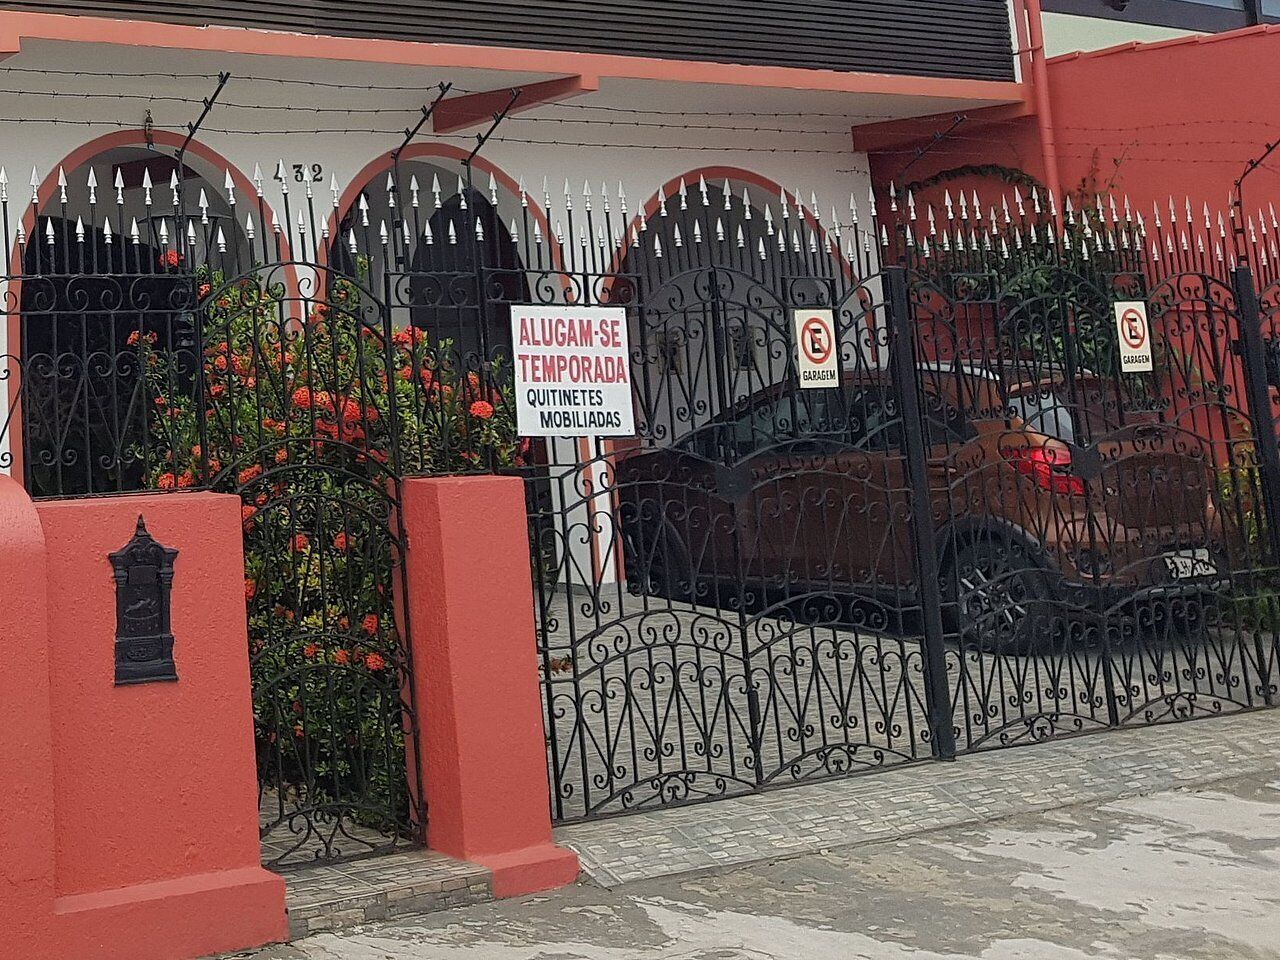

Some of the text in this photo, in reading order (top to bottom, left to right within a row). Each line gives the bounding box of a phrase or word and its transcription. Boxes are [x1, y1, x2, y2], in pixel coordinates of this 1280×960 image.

[519, 317, 622, 348] ALUGAM-SE
[518, 354, 628, 384] TEMPORADA
[1123, 354, 1150, 365] GARAGEM
[803, 369, 836, 381] GARAGEM
[526, 388, 603, 408] QUITINETES
[539, 410, 622, 429] MOBILIADAS
